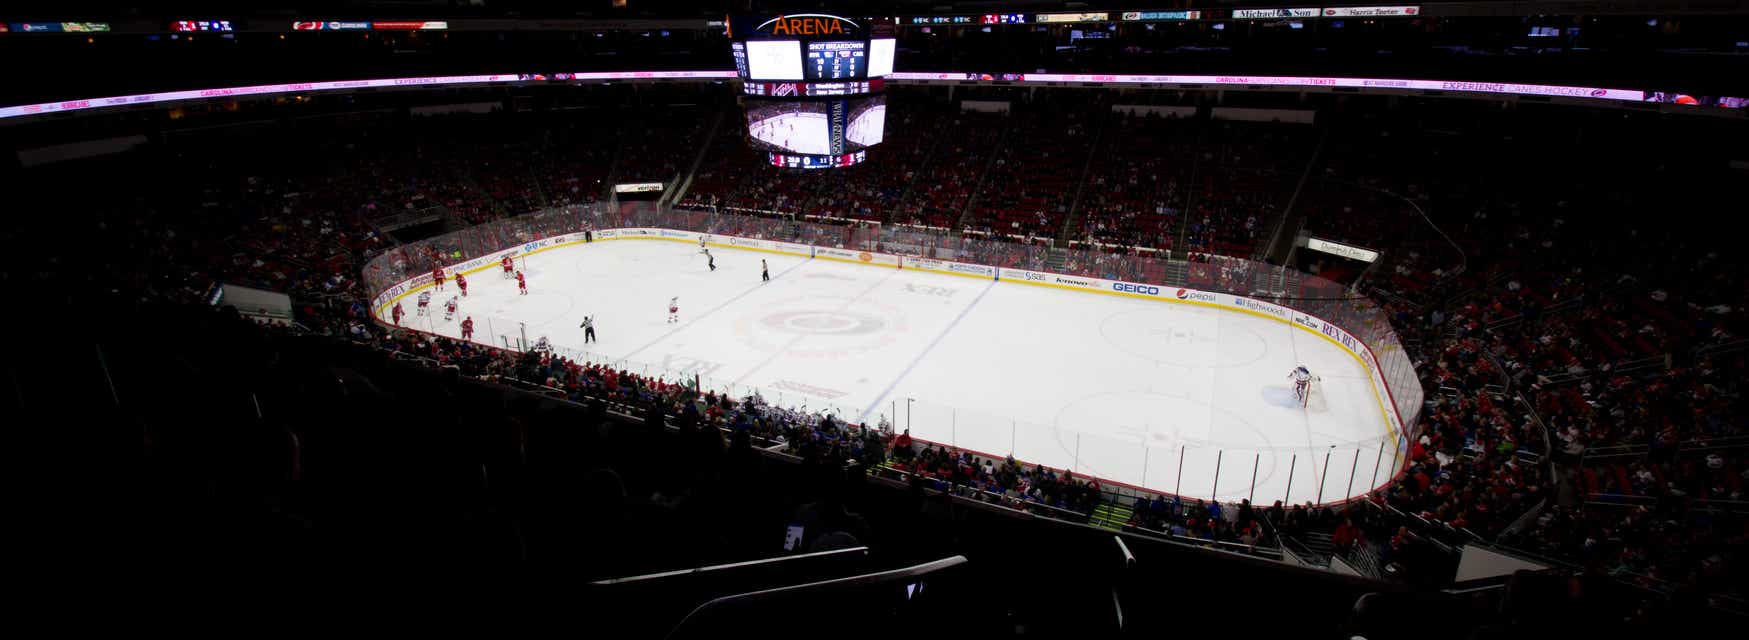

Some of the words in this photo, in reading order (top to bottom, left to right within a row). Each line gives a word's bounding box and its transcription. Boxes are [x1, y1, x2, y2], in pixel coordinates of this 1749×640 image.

[1241, 9, 1276, 18] Michael
[1294, 9, 1311, 17] Son
[1350, 8, 1374, 16] Harris
[1375, 7, 1399, 15] Teeter
[774, 15, 842, 35] ARENA
[395, 77, 437, 86] EXPERIENCE
[1216, 76, 1249, 84] CAROLINA
[200, 88, 233, 97] CAROLINA
[1442, 81, 1505, 93] EXPERIENCE
[1544, 86, 1588, 97] HOCKEY
[1056, 277, 1088, 287] lenovo
[391, 285, 405, 298] REX
[1113, 282, 1159, 295] GEICO
[1189, 291, 1217, 302] pepsi
[1242, 298, 1286, 317] Highwoods
[1321, 322, 1341, 340] REX
[1342, 334, 1358, 352] REX
